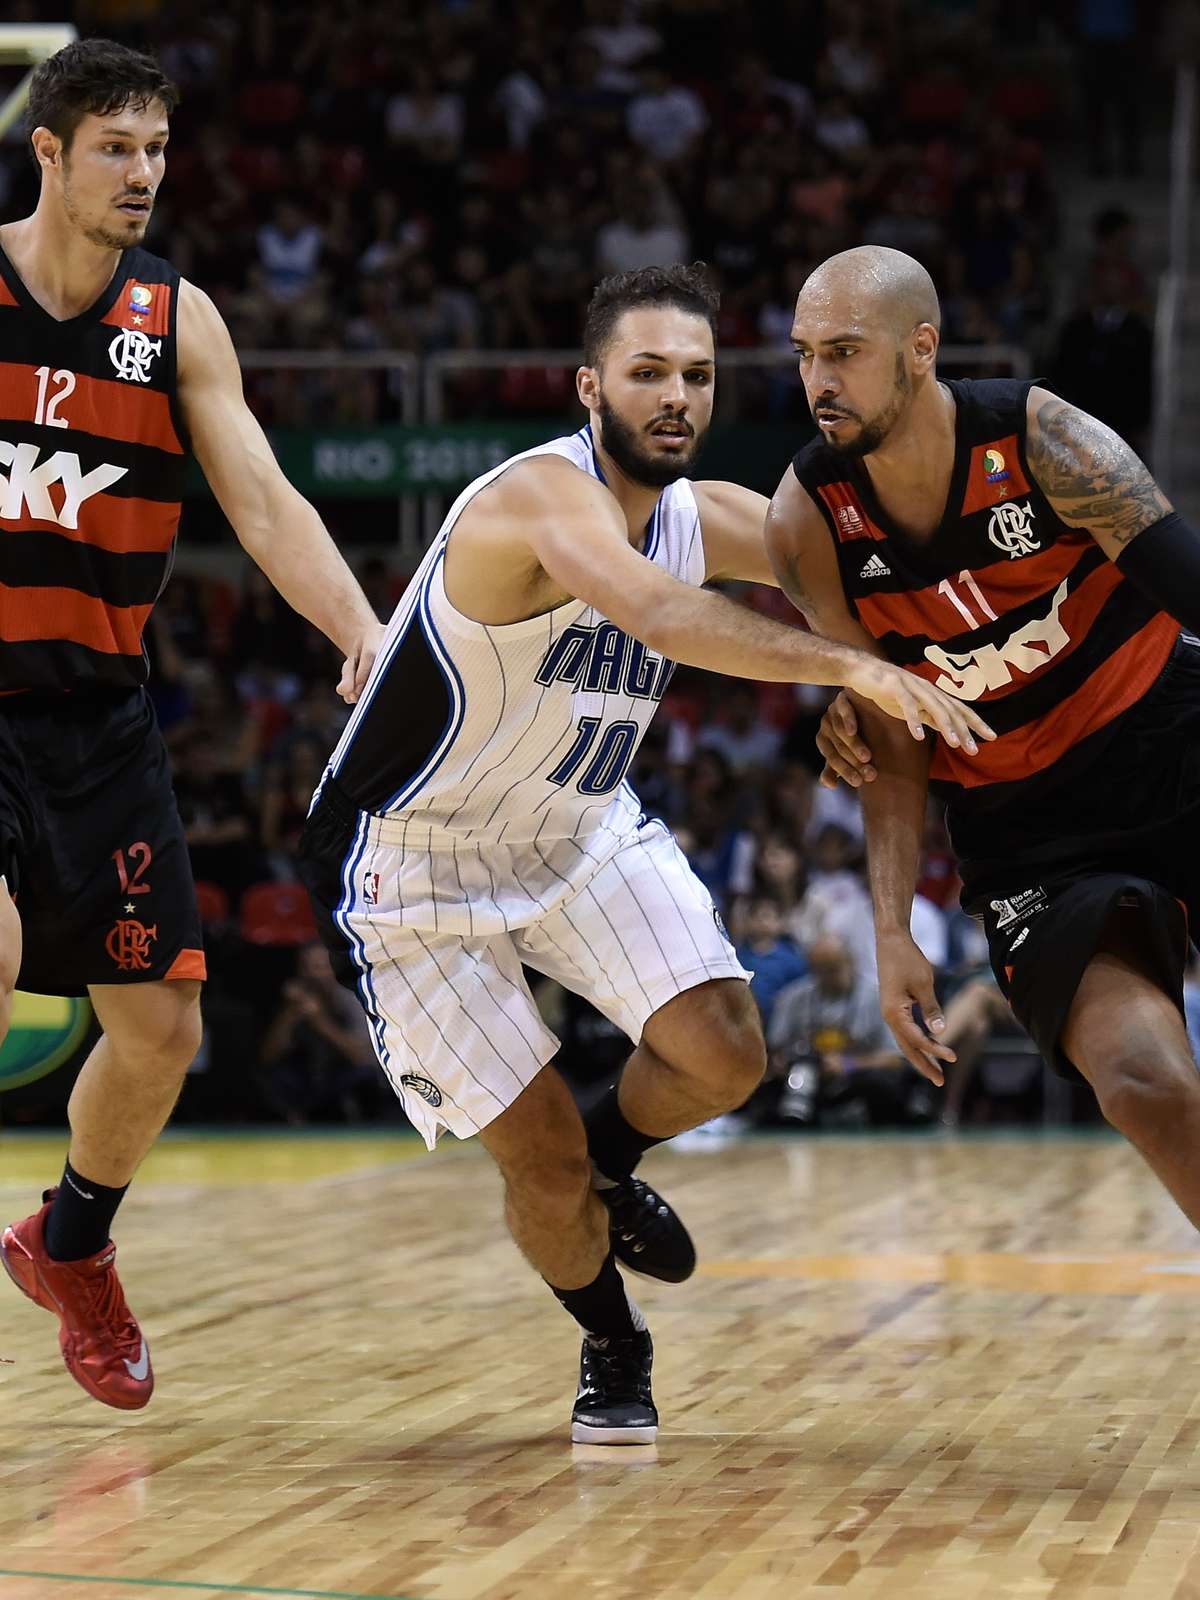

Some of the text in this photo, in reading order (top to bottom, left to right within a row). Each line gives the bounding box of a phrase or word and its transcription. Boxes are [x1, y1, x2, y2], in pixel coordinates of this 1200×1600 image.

[34, 366, 76, 428] 12
[314, 440, 394, 481] RIO
[860, 568, 891, 578] adidas
[938, 569, 998, 630] 11
[924, 577, 1070, 700] SKY
[546, 716, 638, 795] 10
[112, 841, 151, 895] 12
